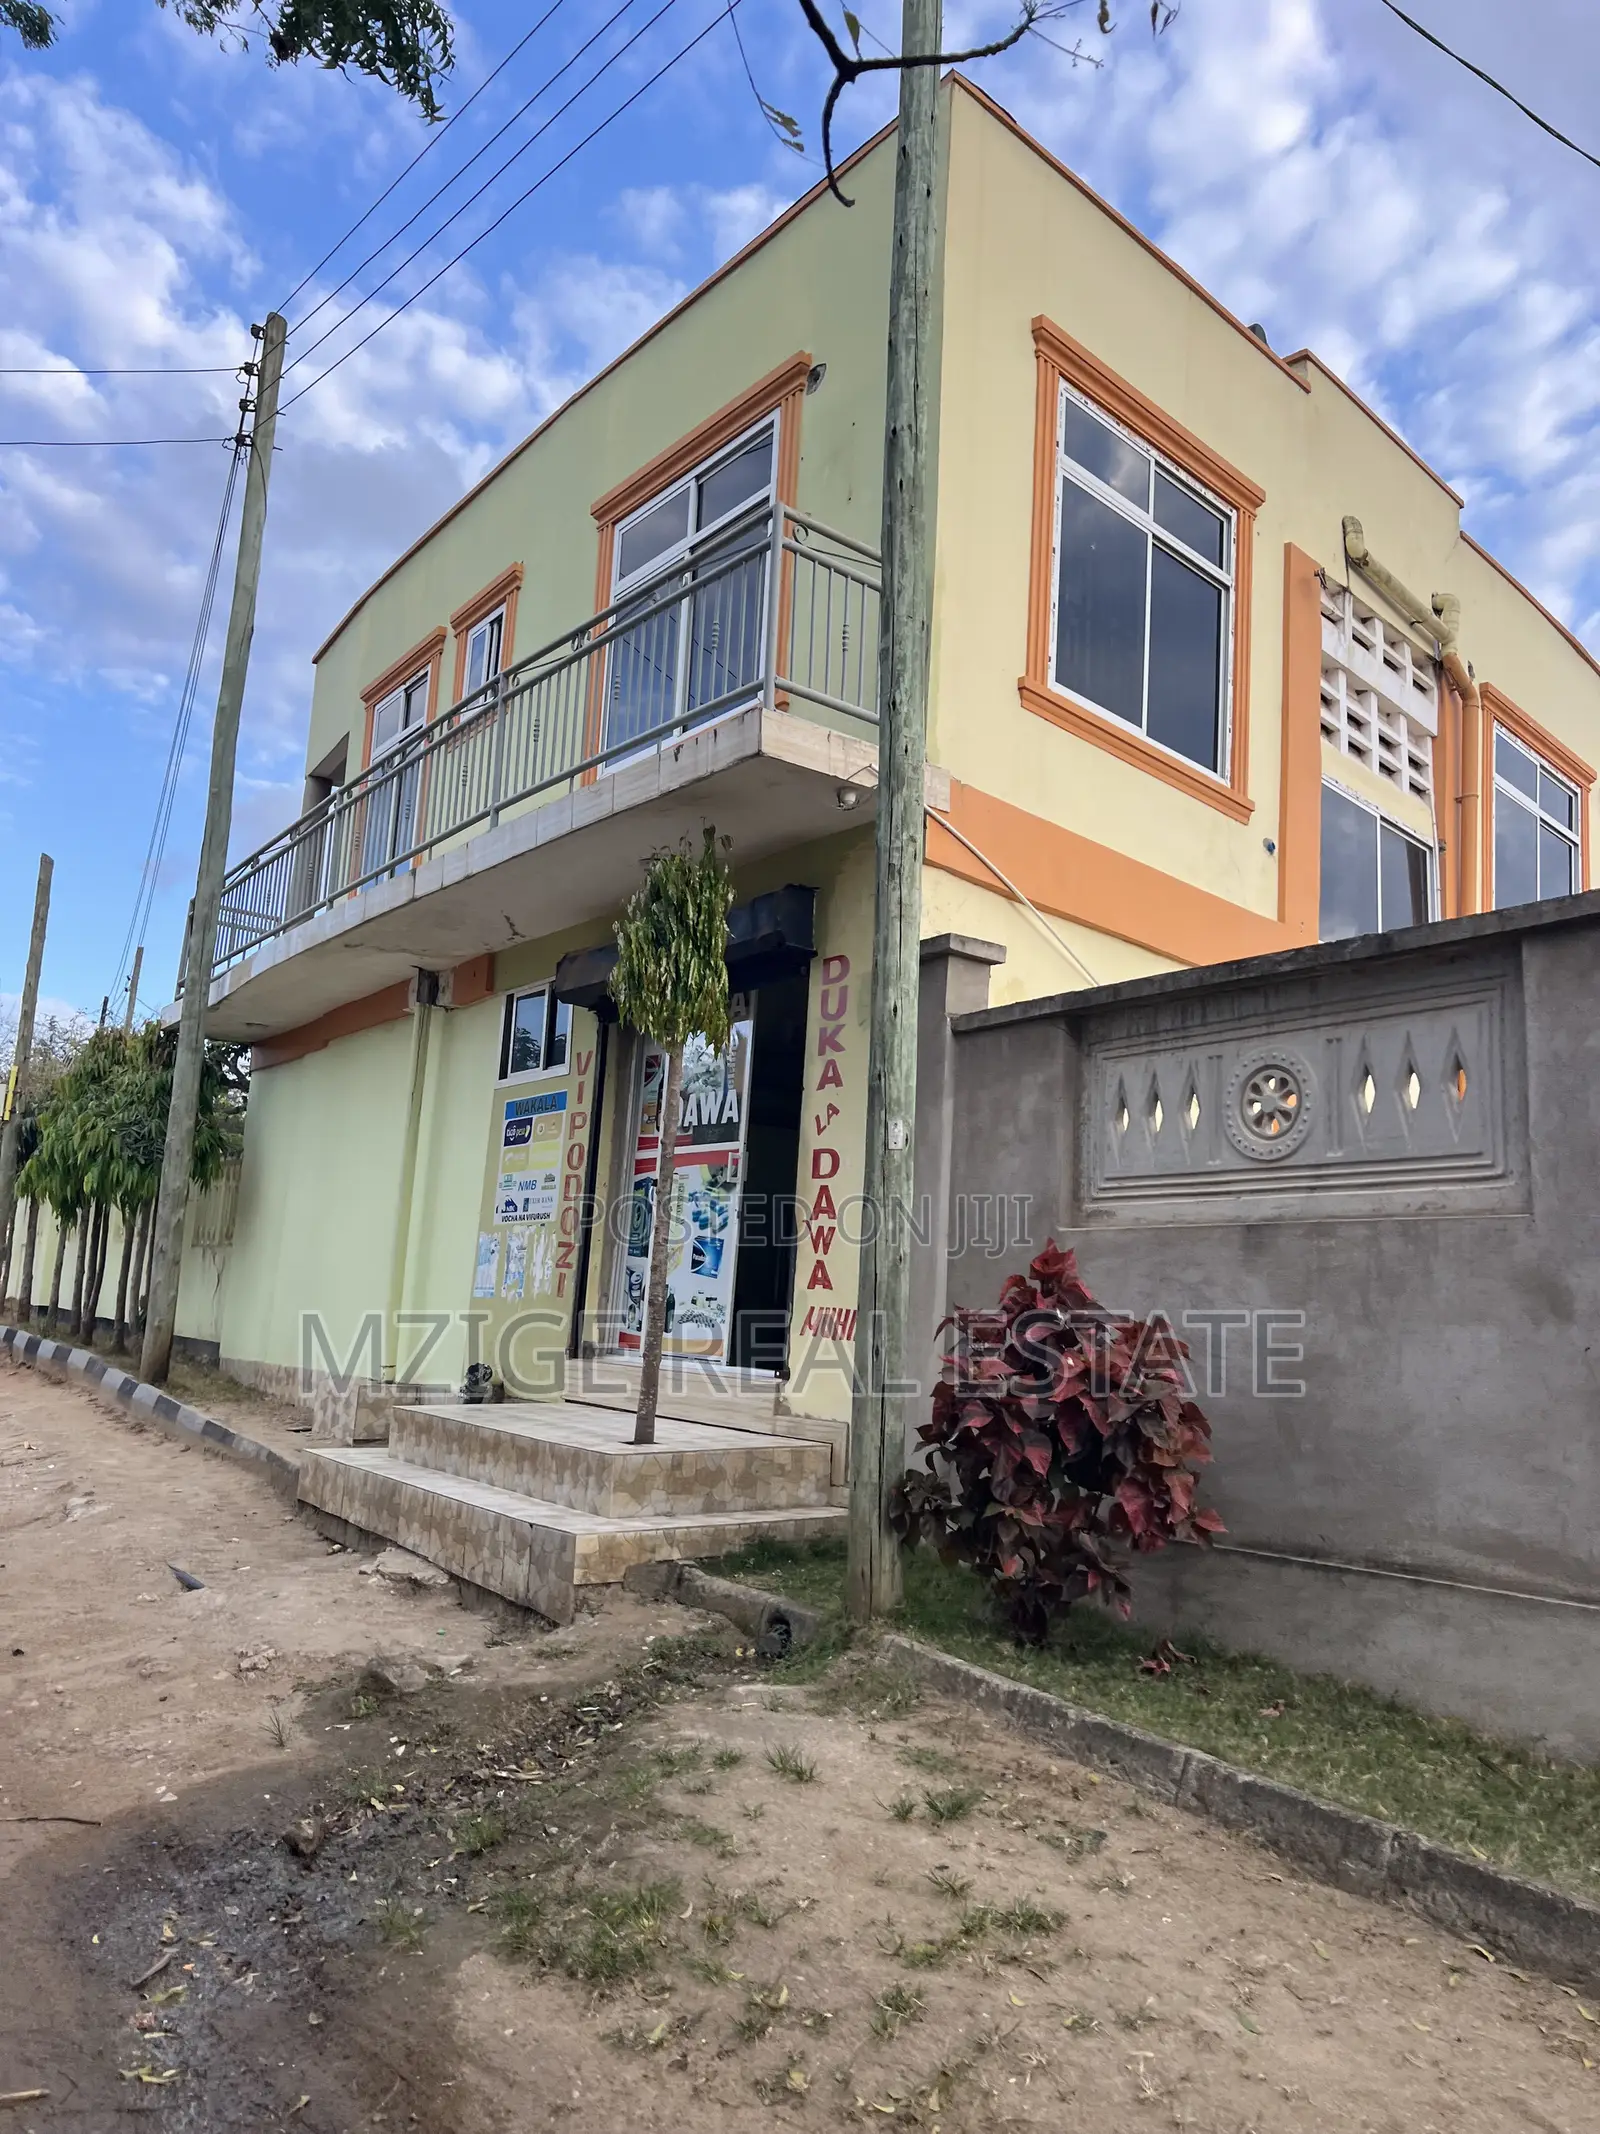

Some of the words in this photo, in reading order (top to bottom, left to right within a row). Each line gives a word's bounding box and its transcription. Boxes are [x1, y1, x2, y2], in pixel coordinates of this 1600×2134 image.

[815, 954, 851, 1092] DUKA
[515, 1095, 557, 1117] WAKALA
[815, 1102, 841, 1136] LA
[517, 1179, 538, 1192] NMB
[555, 1050, 594, 1298] VIPODOZI
[804, 1148, 842, 1291] DAWA
[799, 1305, 858, 1341] MUHI
